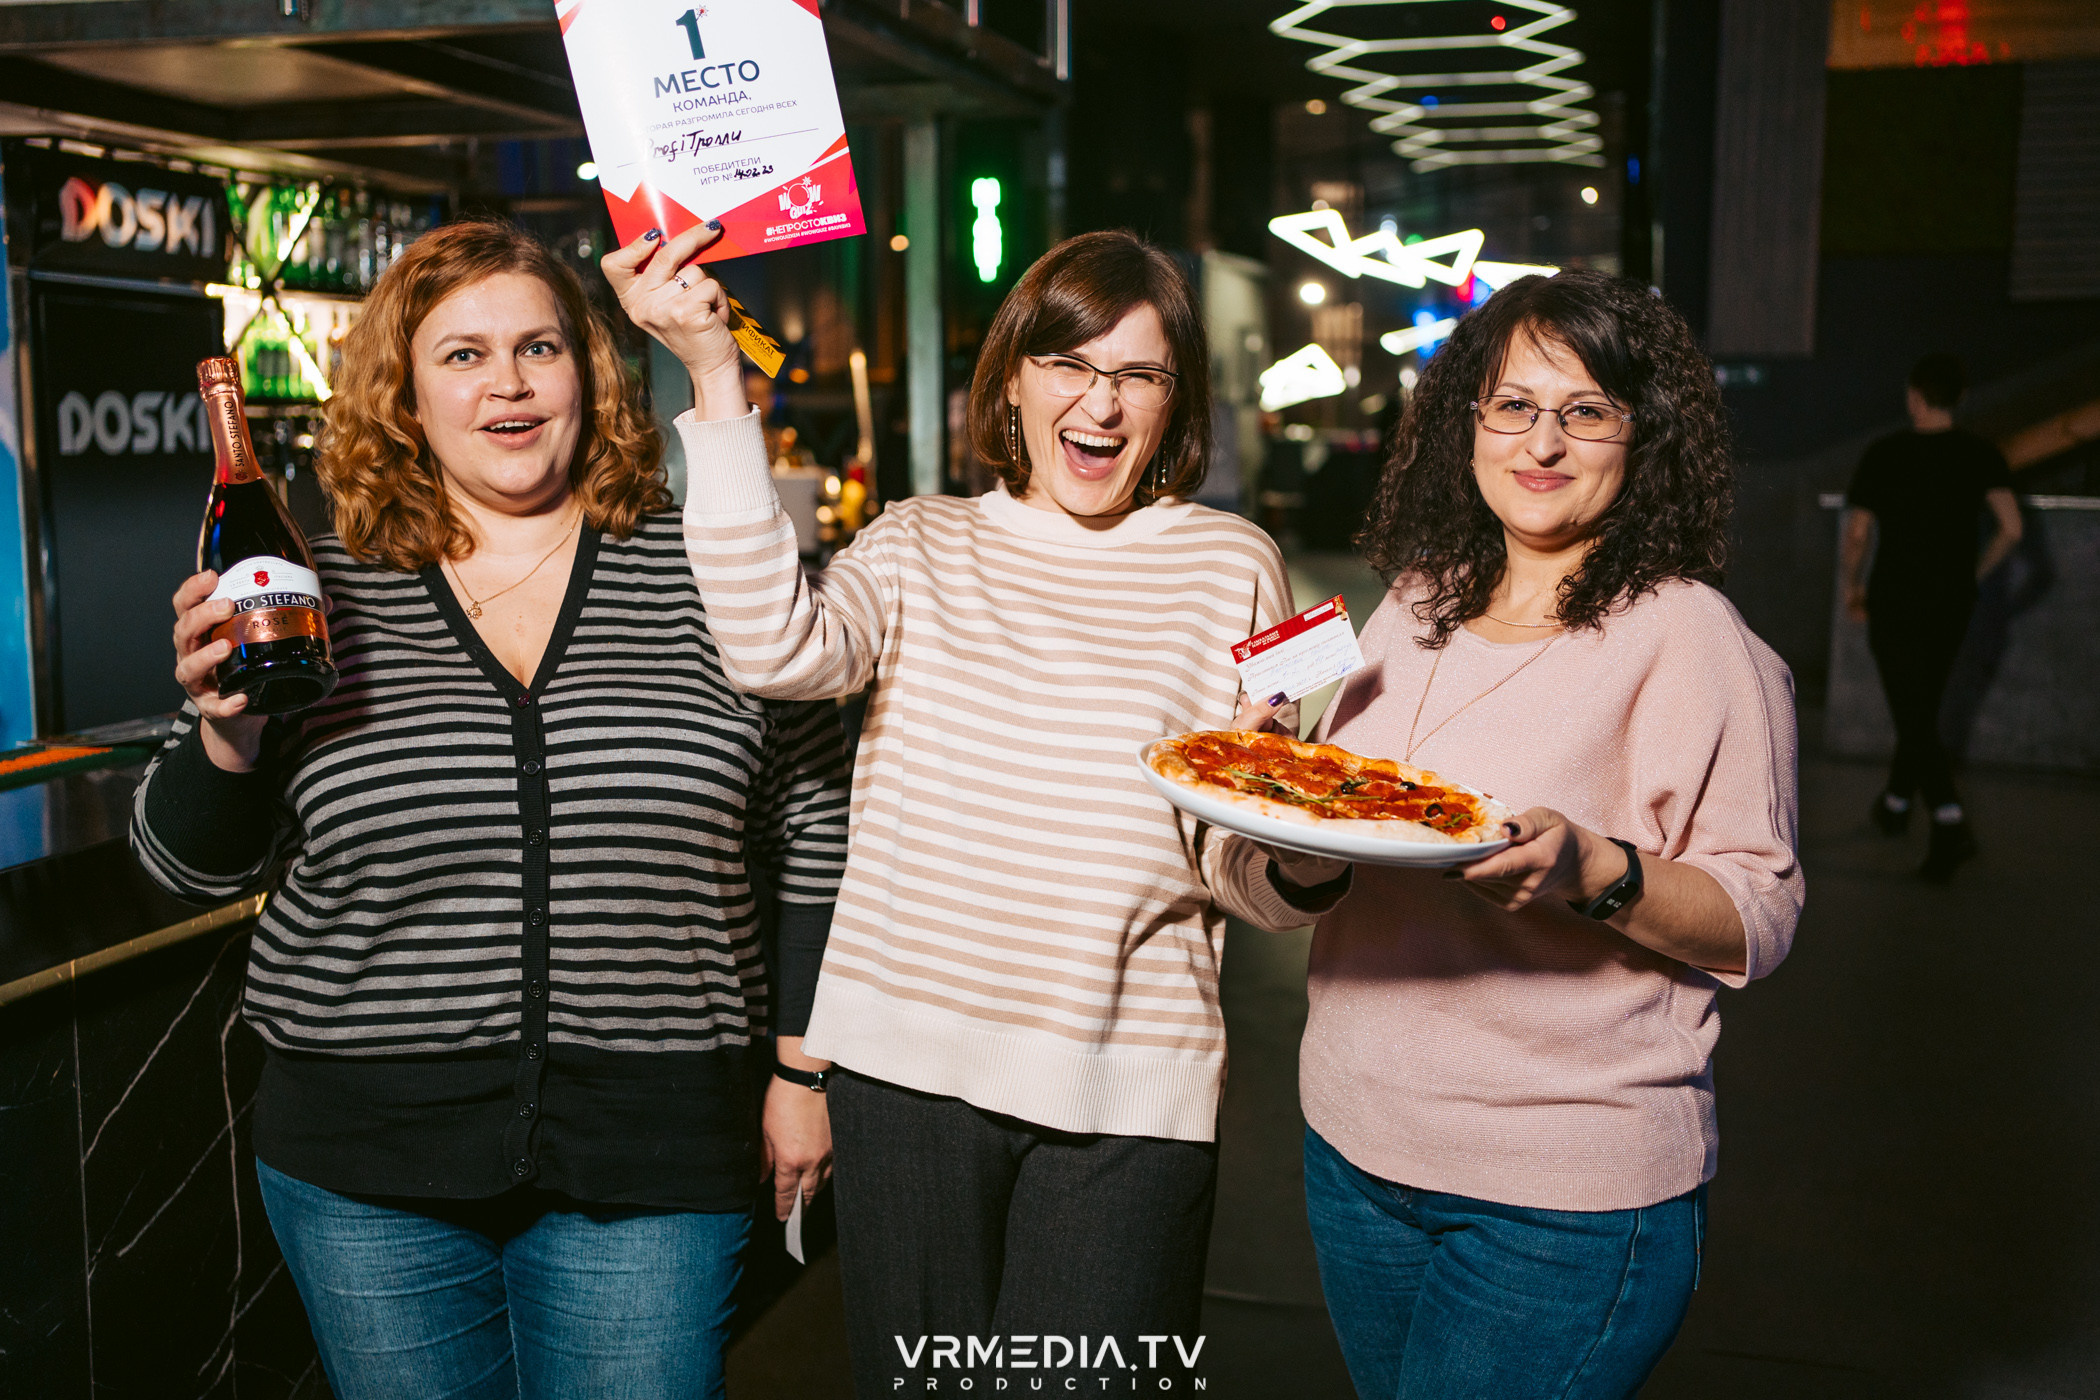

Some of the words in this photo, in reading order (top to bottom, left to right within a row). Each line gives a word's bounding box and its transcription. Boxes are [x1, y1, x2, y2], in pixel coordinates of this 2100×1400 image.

[676, 9, 705, 60] 1
[654, 60, 760, 98] МЕСТО
[646, 121, 674, 133] ОРАЯ
[675, 111, 734, 127] РАЗГРОМИЛА
[735, 103, 775, 117] СЕГОДНЯ
[776, 99, 798, 110] ВСЕХ
[673, 90, 752, 113] КОМАНДА,
[693, 156, 761, 175] ПОБЕДИТЕЛИ
[700, 175, 720, 186] ИГР
[778, 183, 822, 212] WOW
[789, 202, 814, 219] QUIZ
[59, 177, 216, 258] DOSKI
[765, 213, 848, 236] #НЕПРОСТОКВИЗ
[741, 320, 776, 356] ИФИКАТ
[58, 390, 211, 456] DOSKI
[224, 401, 240, 439] STEFANO
[231, 441, 245, 467] SANTO
[236, 598, 255, 613] TO
[260, 594, 316, 608] STEFANO
